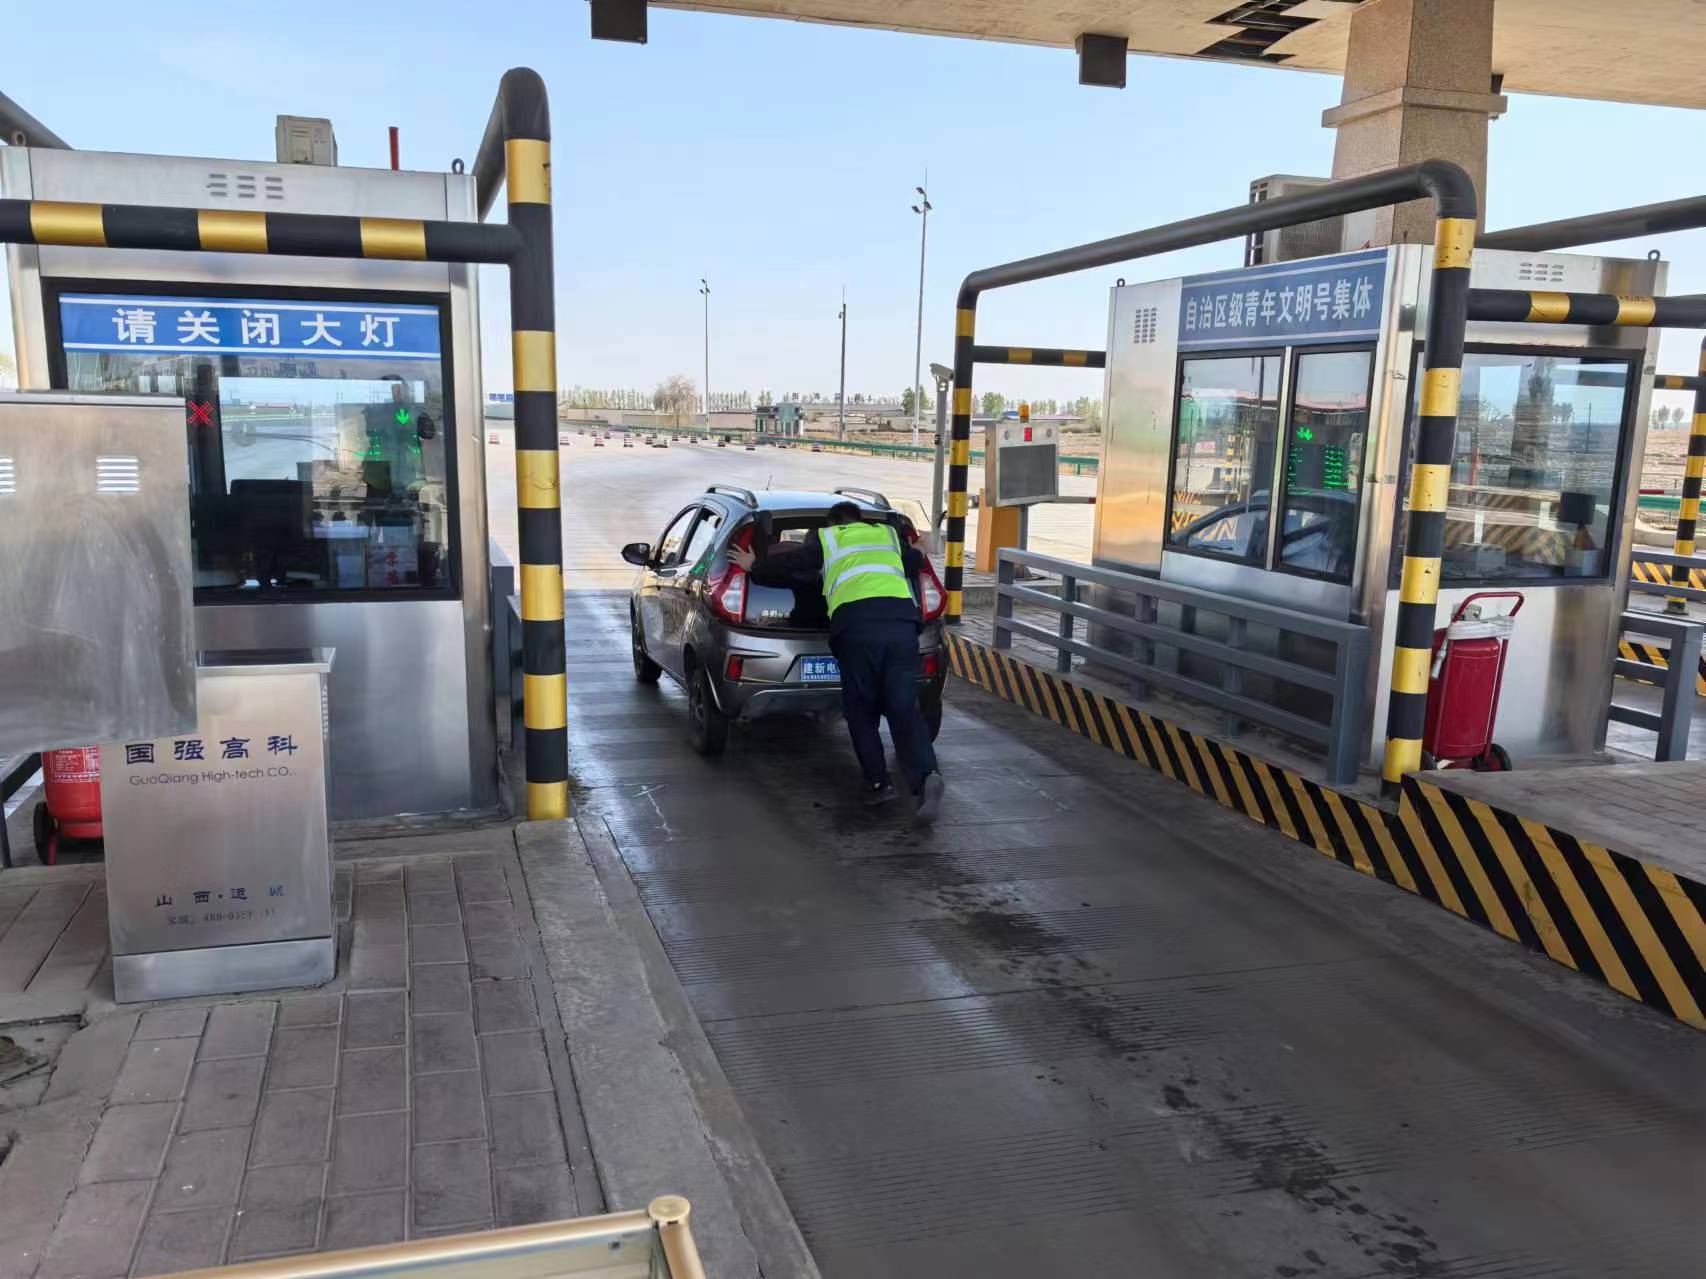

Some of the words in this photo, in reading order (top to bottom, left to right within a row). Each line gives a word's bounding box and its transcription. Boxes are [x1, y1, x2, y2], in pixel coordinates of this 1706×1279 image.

[1185, 276, 1373, 331] 自治区级青年文明号集体
[112, 308, 400, 347] 请关闭大灯
[125, 734, 298, 765] 国强高科
[129, 773, 199, 786] GuoQiang
[202, 768, 264, 782] High-tech
